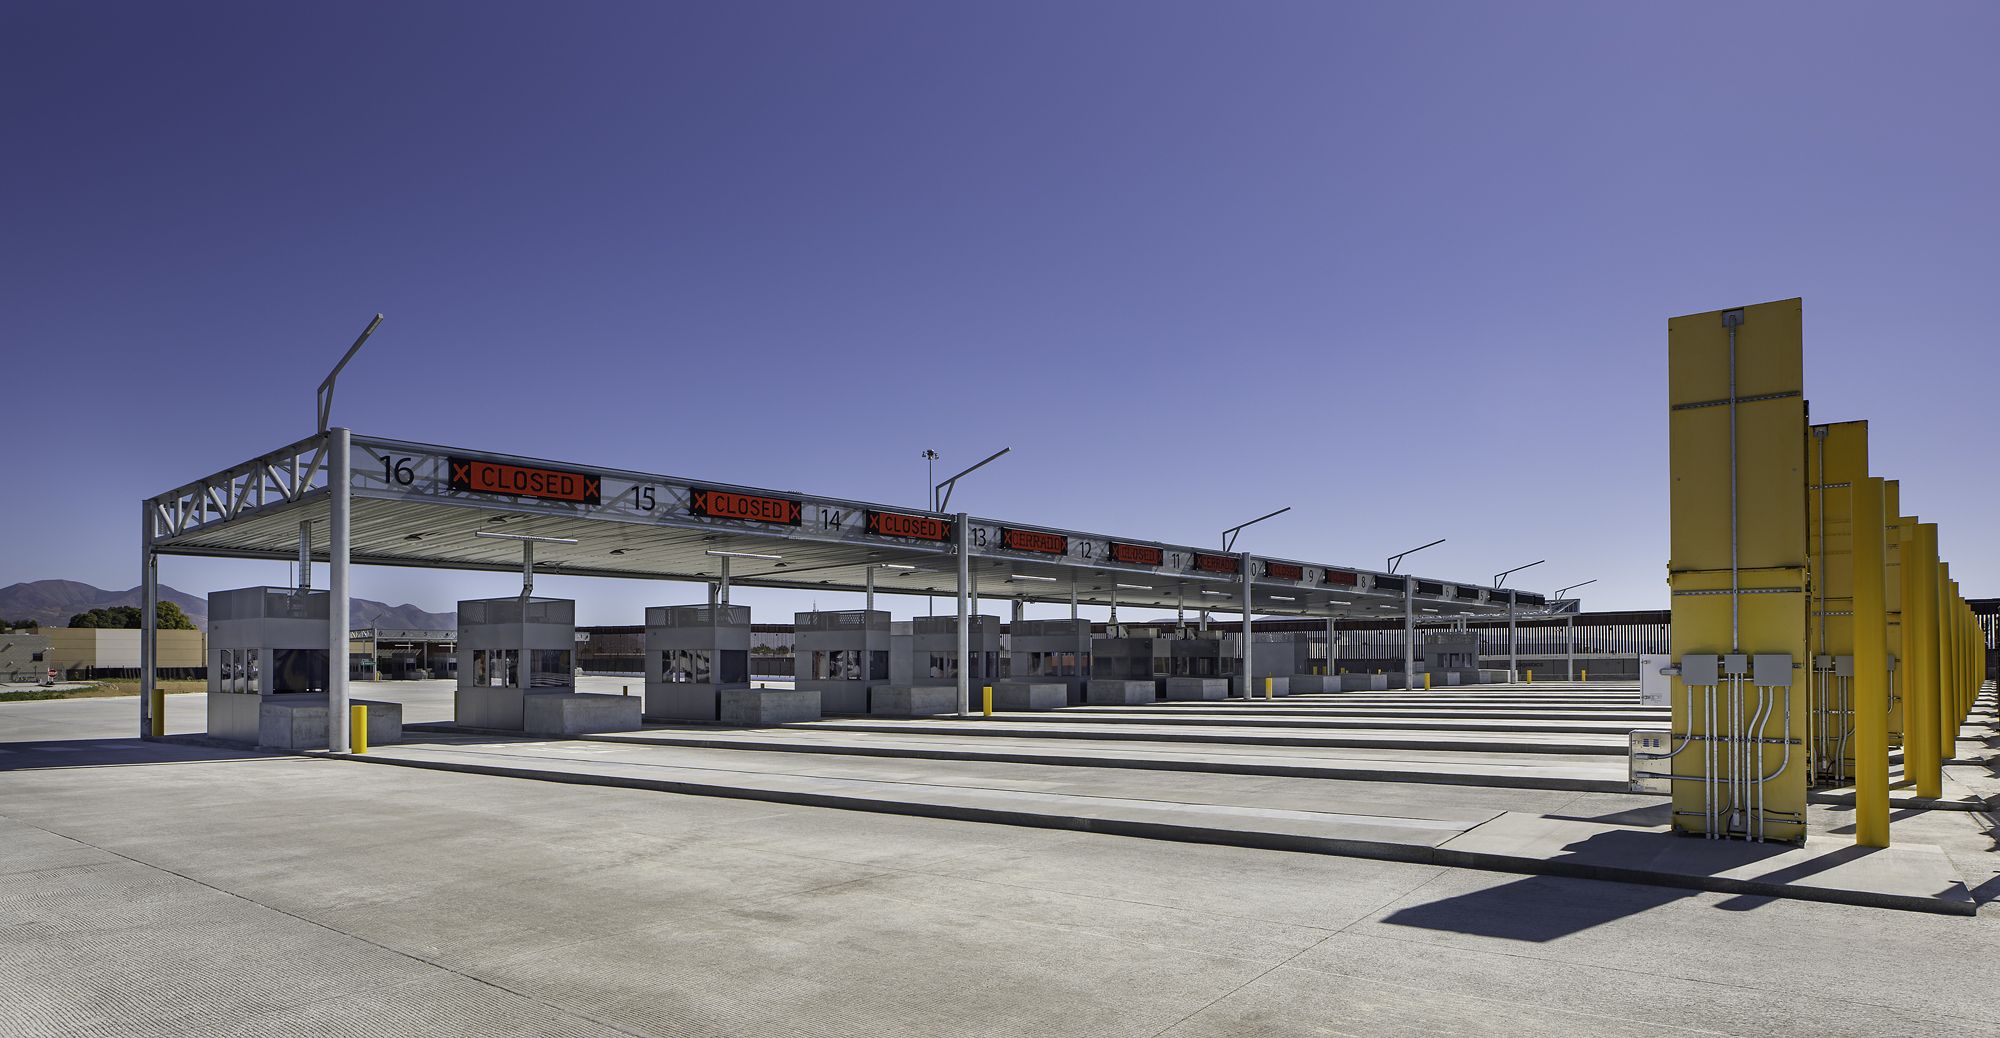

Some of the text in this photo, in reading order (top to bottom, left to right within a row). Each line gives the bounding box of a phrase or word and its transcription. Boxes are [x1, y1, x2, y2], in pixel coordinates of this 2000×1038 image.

[380, 456, 414, 486] 16
[481, 467, 574, 496] CLOSED
[631, 485, 656, 511] 15
[714, 496, 783, 519] CLOSED
[821, 509, 841, 531] 14
[885, 516, 937, 537] CLOSED
[971, 528, 986, 547] 13
[1012, 533, 1060, 551] CERRADO
[1079, 541, 1092, 559] 12
[1120, 545, 1155, 562] CLOSED
[1171, 553, 1180, 569] 11
[1202, 557, 1235, 572] CERRADO
[1250, 562, 1257, 577] 0
[1274, 564, 1298, 578] CLOSED
[1308, 569, 1314, 583] 9
[1332, 571, 1353, 584] CLOSED
[1361, 576, 1366, 588] 8
[1445, 586, 1450, 598] 6
